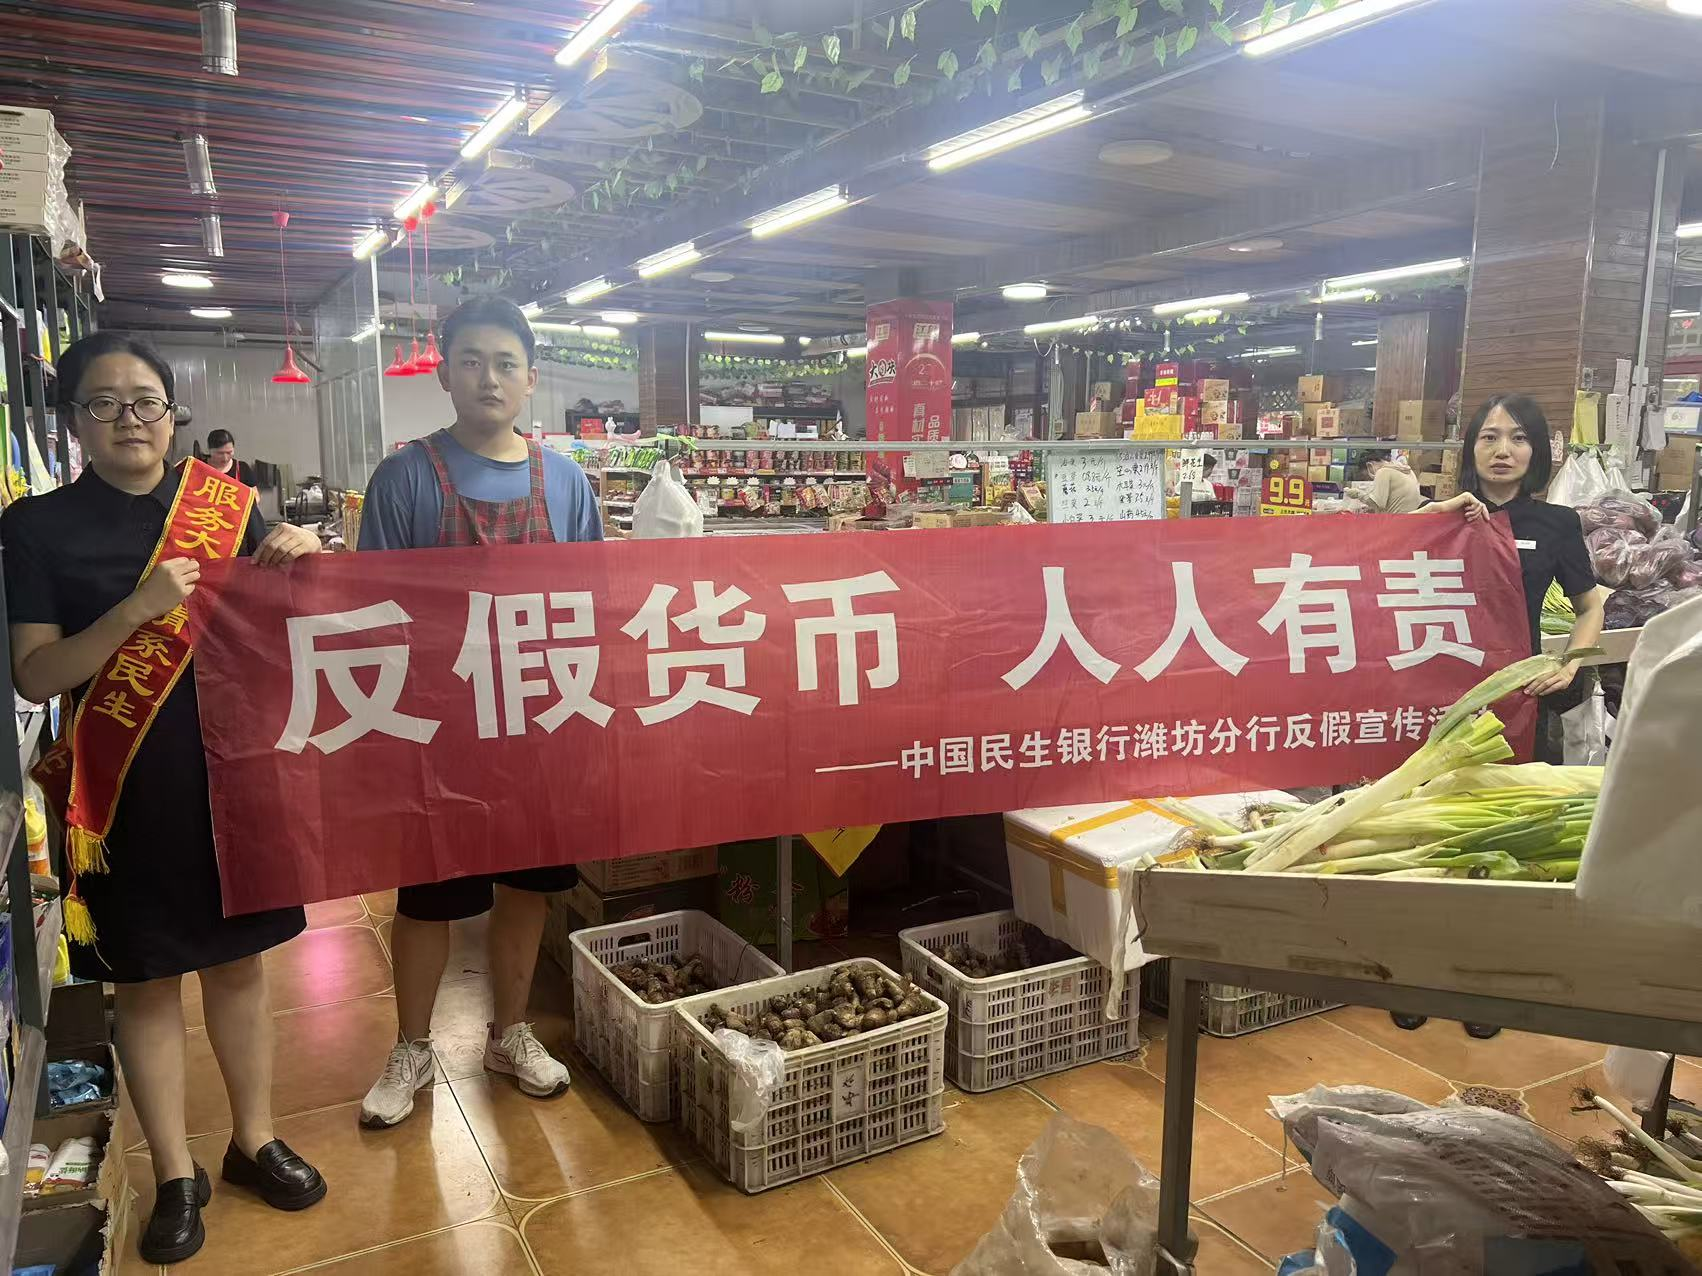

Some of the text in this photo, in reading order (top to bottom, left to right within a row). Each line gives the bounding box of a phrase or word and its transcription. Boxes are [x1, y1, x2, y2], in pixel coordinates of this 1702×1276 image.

[1269, 476, 1304, 506] 9.9
[274, 550, 1486, 755] 反假货币 人人有责
